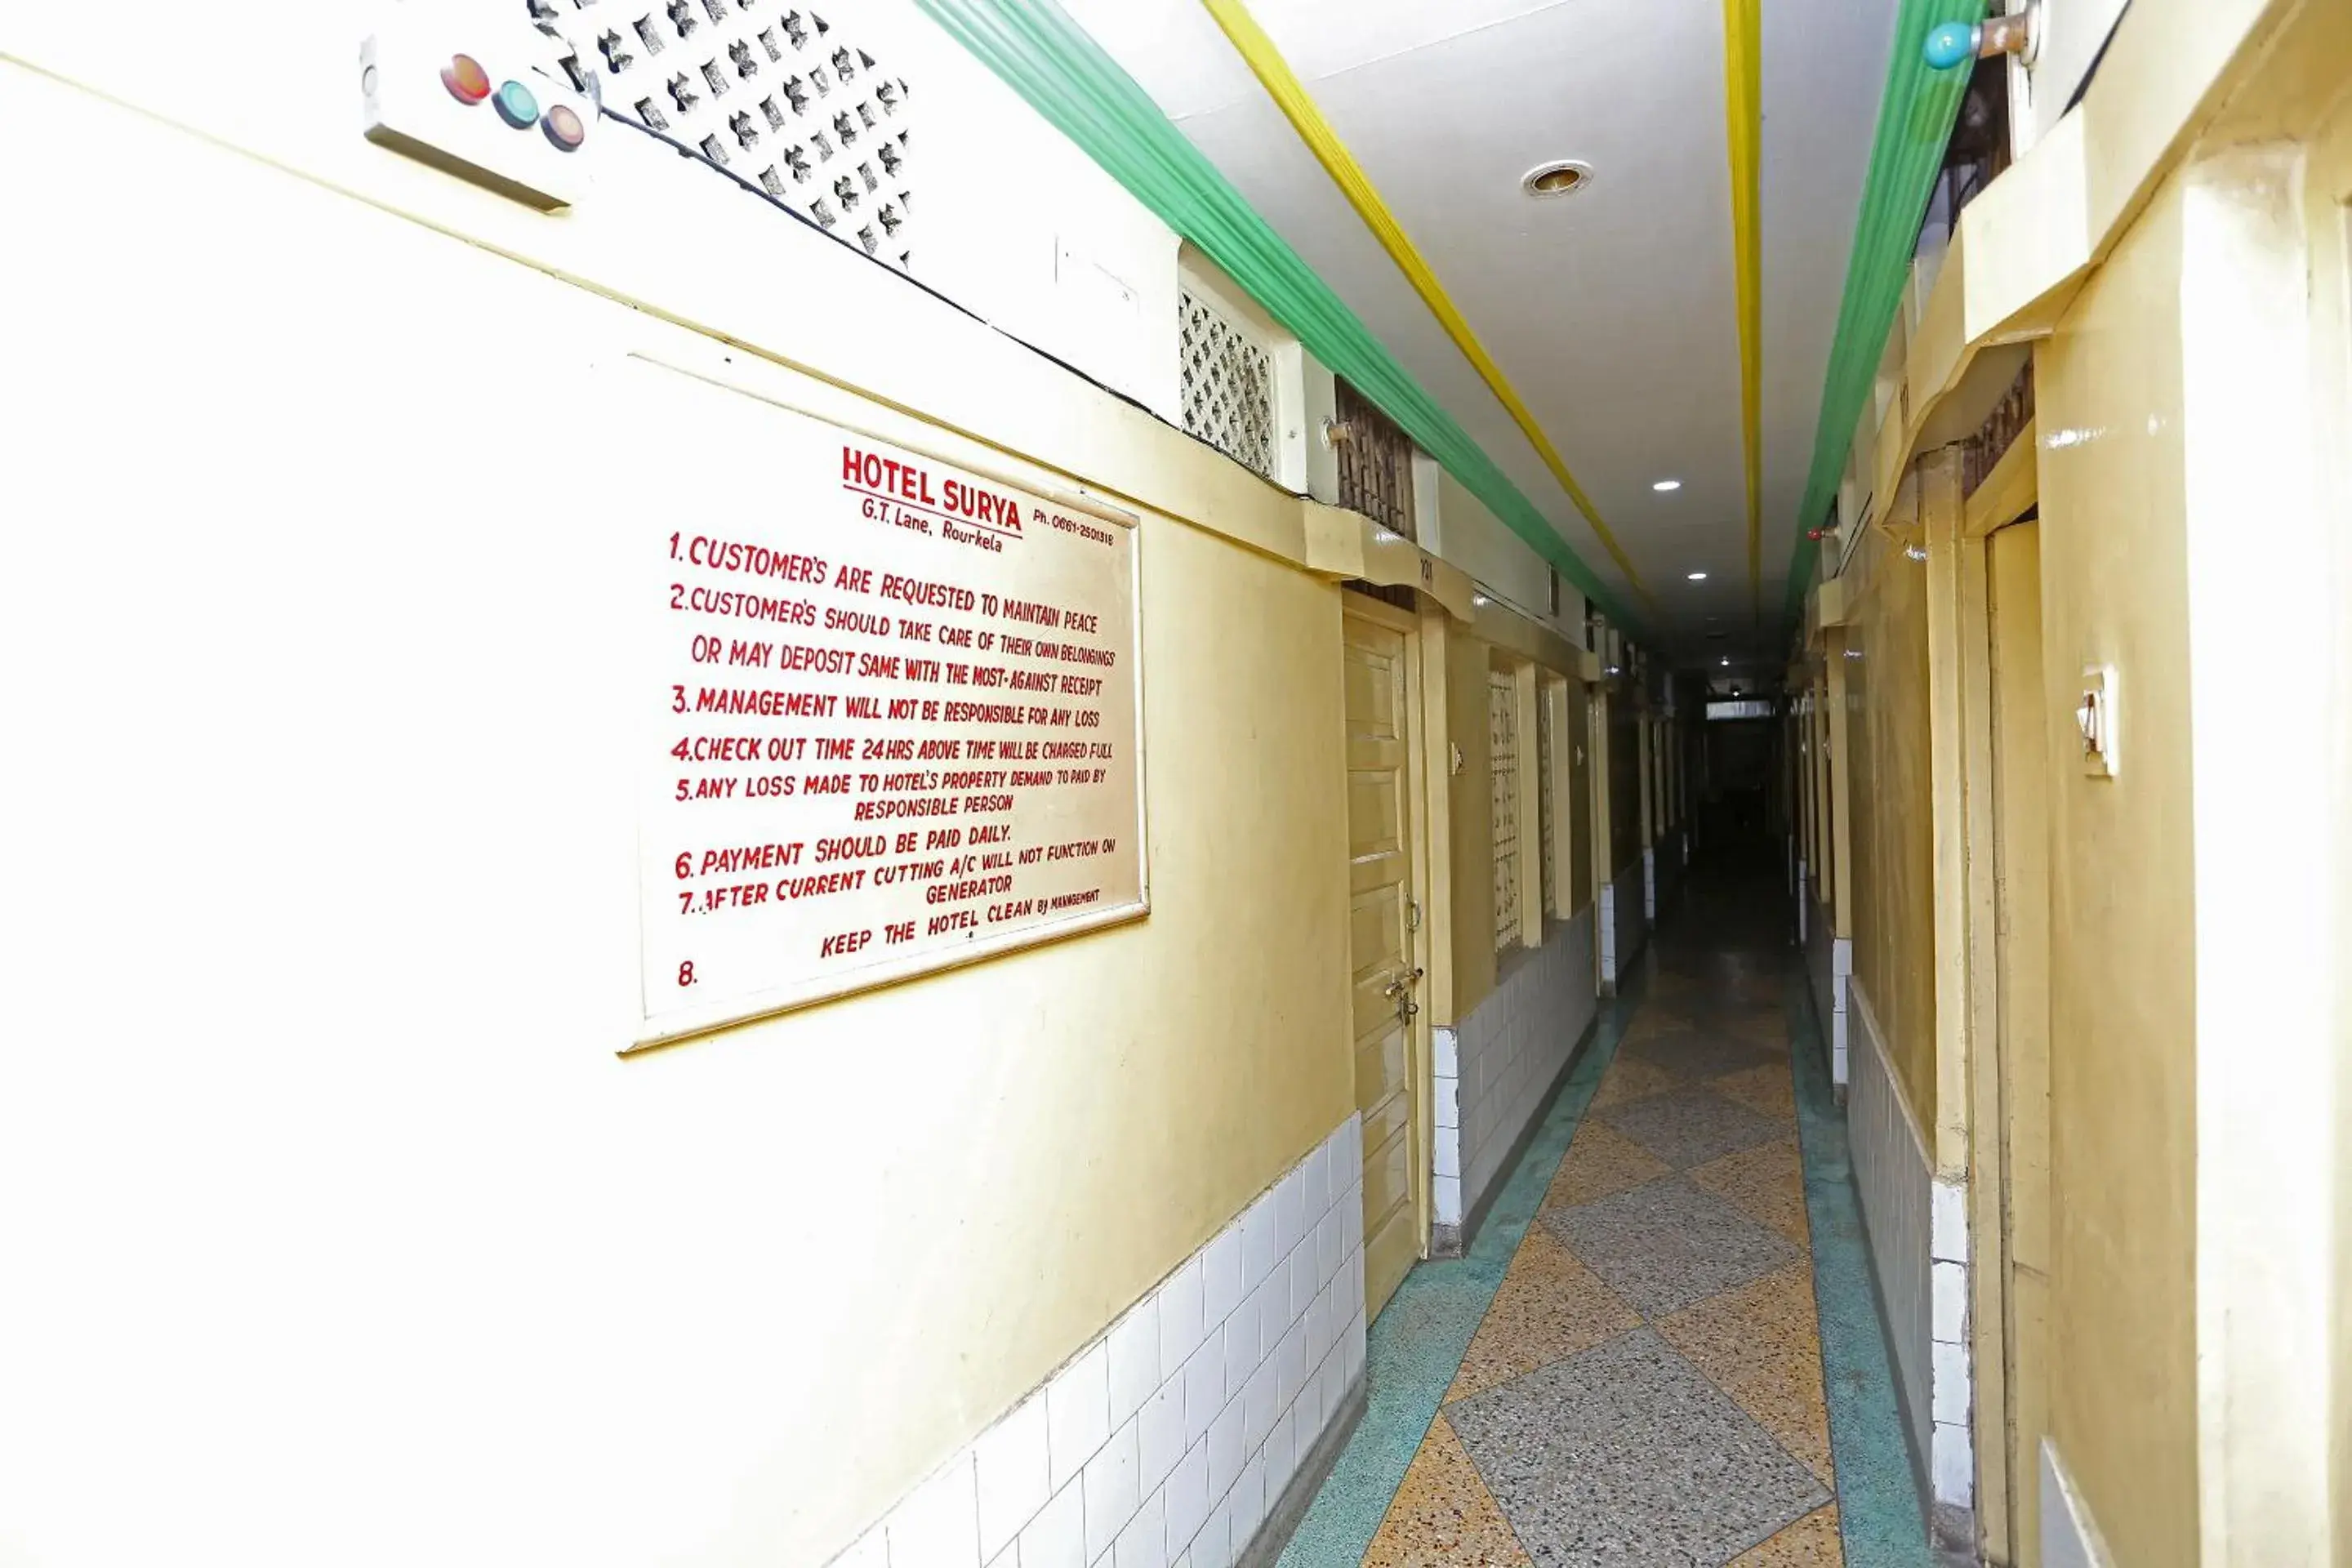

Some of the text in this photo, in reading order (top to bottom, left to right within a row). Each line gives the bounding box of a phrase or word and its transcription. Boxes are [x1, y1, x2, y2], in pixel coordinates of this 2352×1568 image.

[842, 446, 1022, 532] HOTEL SURYA
[894, 506, 933, 537] Lane,
[942, 520, 1004, 553] Rourkela
[1032, 508, 1050, 526] Ph.
[688, 535, 828, 585] CUSTOMER'S
[833, 564, 873, 595] ARE
[880, 572, 976, 612] REQUESTED
[981, 593, 999, 617] TO
[1002, 598, 1061, 628] MAINTAIN
[1063, 610, 1098, 635] PEACE
[823, 607, 891, 637] SHOULD
[898, 618, 933, 643] TAKE
[938, 625, 973, 648] CARE
[978, 630, 996, 652] OF
[1000, 634, 1034, 657] THEIR
[1034, 640, 1060, 660] OWN
[1060, 644, 1116, 667] BELONGINGS
[691, 634, 723, 664] OR
[728, 639, 774, 669] MAY
[780, 644, 857, 675] DEPOSIT
[857, 652, 901, 680] SAME
[904, 657, 941, 684] WITH
[945, 662, 970, 685] THE
[1059, 675, 1103, 697] RECEIPT
[695, 687, 839, 718] MANAGEMENT
[845, 695, 883, 719] WILL
[887, 698, 920, 720] NOT
[920, 699, 940, 722] BE
[942, 701, 1025, 725] RESPONSIBLE
[1027, 706, 1049, 726] FOR
[1049, 707, 1072, 728] ANY
[1074, 710, 1100, 728] LOSS
[767, 737, 808, 762] OUT
[814, 737, 856, 761] TIME
[916, 739, 961, 760] ABOVE
[965, 739, 996, 760] TIME
[998, 740, 1023, 760] WILL
[1024, 741, 1040, 760] BE
[1041, 741, 1088, 760] CHARGED
[1089, 742, 1112, 760] FULL
[745, 775, 796, 798] LOSS
[803, 773, 853, 796] MADE
[858, 773, 880, 793] TO
[882, 769, 939, 791] HOTEL'S
[941, 770, 1008, 790] PROPERTY
[1009, 770, 1054, 787] DEMAND
[1056, 769, 1069, 785] TO
[1070, 768, 1091, 785] PAID
[1092, 768, 1107, 784] BY
[853, 785, 1014, 822] RESPONSIBLE PERSON
[699, 842, 804, 876] PAYMENT
[814, 835, 887, 863] SHOULD
[894, 831, 919, 854] BE
[925, 828, 962, 851] PAID
[968, 824, 1011, 846] DAILY.
[698, 882, 769, 913] AFTER
[775, 869, 866, 902] CURRENT
[873, 858, 945, 887] CUTTING
[949, 853, 977, 879] A/C
[982, 851, 1013, 871] WILL
[1018, 846, 1044, 865] NOT
[1046, 840, 1098, 862] FUNCTION
[1102, 838, 1116, 854] ON
[925, 874, 1013, 906] GENERATOR
[677, 960, 698, 987] 8.
[820, 929, 873, 959] KEEP
[884, 920, 916, 945] THE
[927, 909, 979, 935] HOTEL
[987, 898, 1033, 924] CLEAN
[1049, 888, 1100, 910] MANAGEMENT
